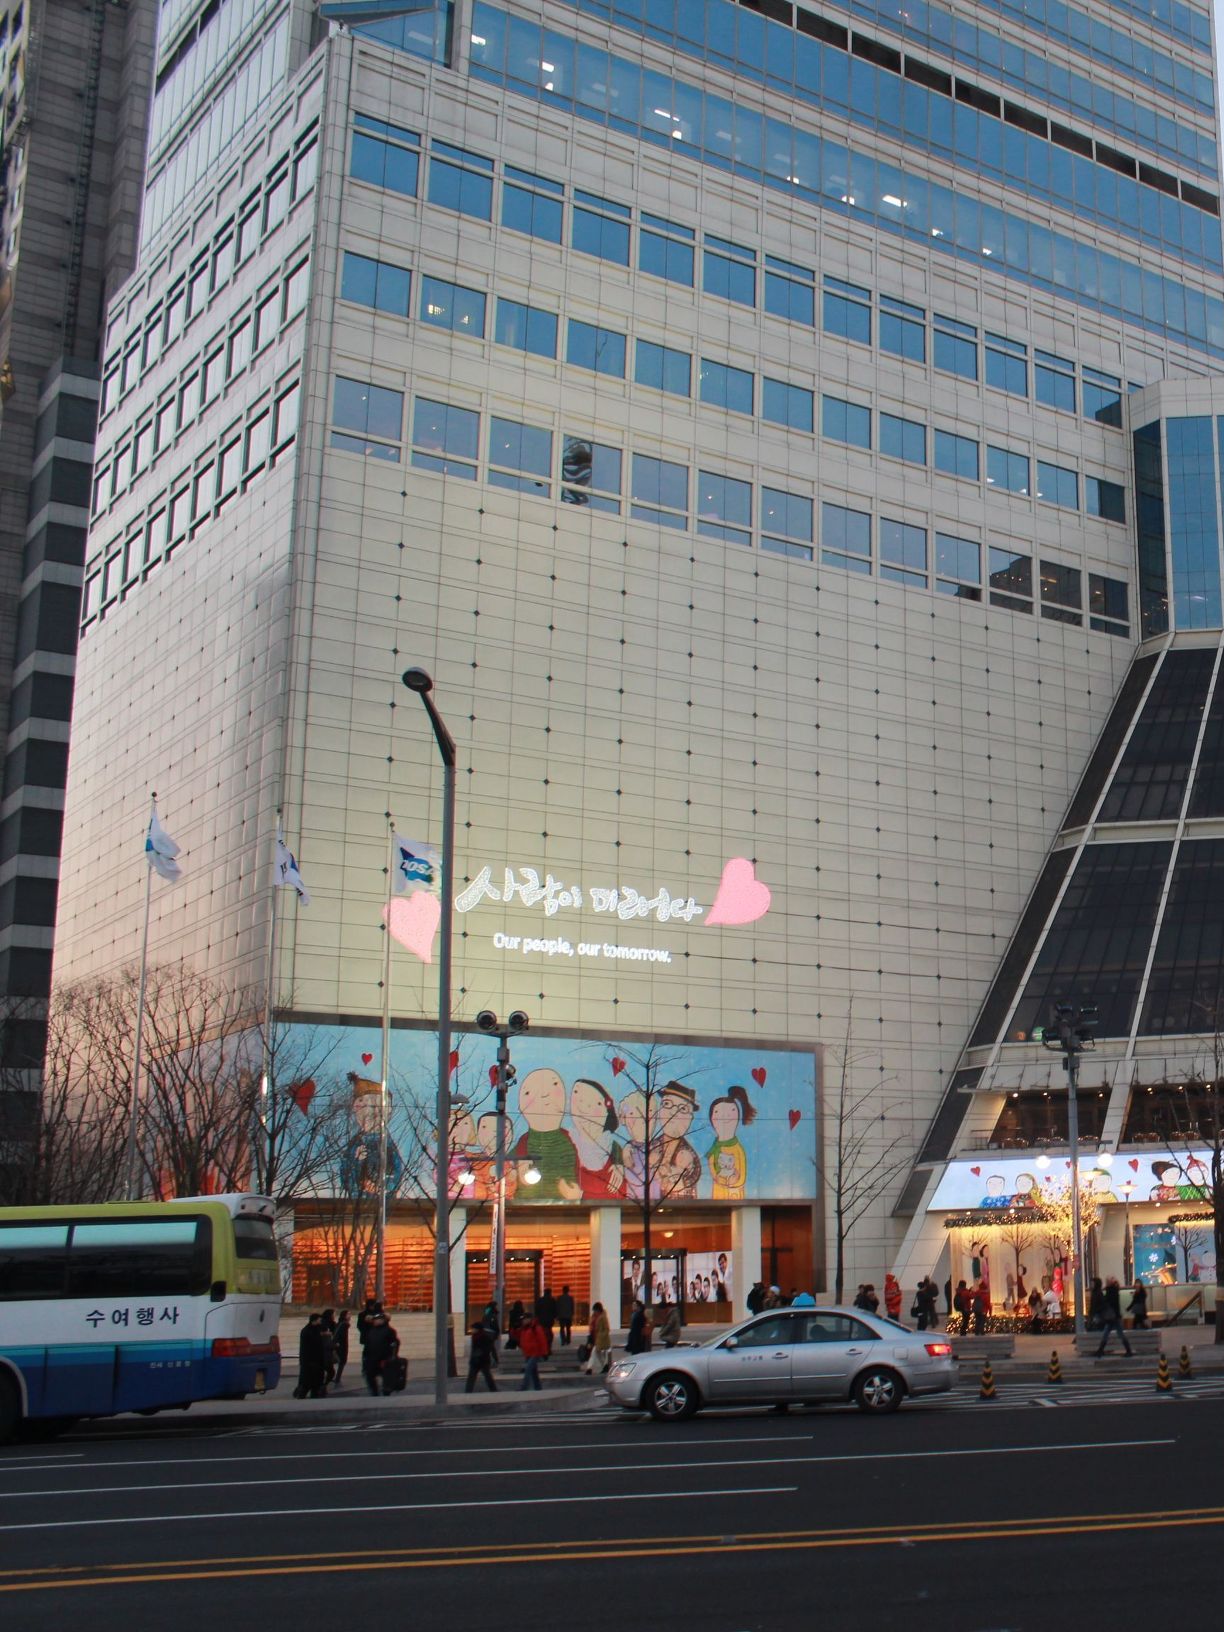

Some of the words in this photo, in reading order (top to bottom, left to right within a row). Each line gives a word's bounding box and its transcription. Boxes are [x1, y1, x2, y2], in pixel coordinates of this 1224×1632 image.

[454, 865, 583, 916] 사람이
[493, 932, 520, 950] Our
[523, 937, 574, 957] people,
[577, 943, 600, 956] our
[602, 943, 672, 963] tomorrow.
[85, 1306, 180, 1328] 수여행사
